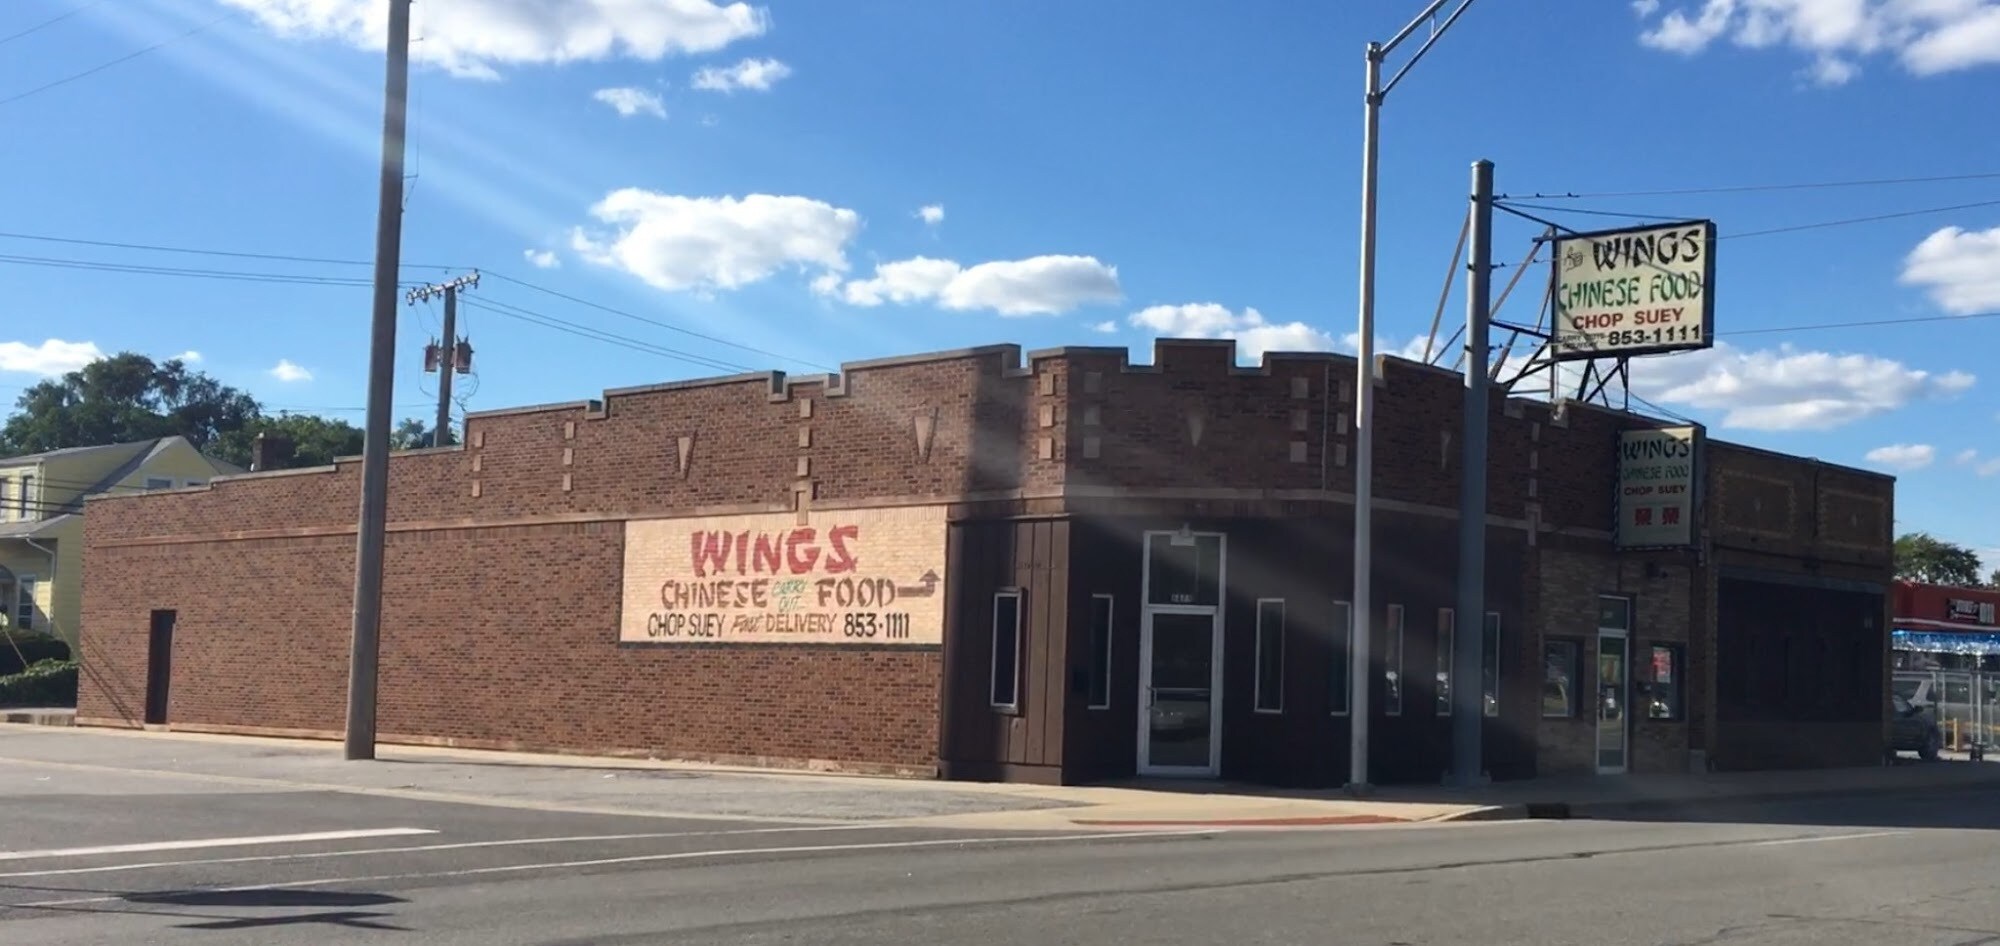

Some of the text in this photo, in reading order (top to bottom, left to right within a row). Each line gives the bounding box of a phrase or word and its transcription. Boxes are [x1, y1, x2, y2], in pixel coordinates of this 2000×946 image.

[1593, 229, 1701, 272] WINGS
[1558, 270, 1702, 310] CHINESE FOOD
[1573, 307, 1685, 330] CHOP SUEY
[1608, 324, 1700, 346] 853-1111
[1623, 437, 1690, 460] WINGS
[1624, 484, 1687, 496] CHOP SUEY
[691, 525, 858, 577] WINGS
[661, 577, 896, 610] CHINESE FOOD
[647, 613, 685, 638] CHOP
[688, 613, 725, 638] SUEY
[765, 612, 838, 633] DELIVERY
